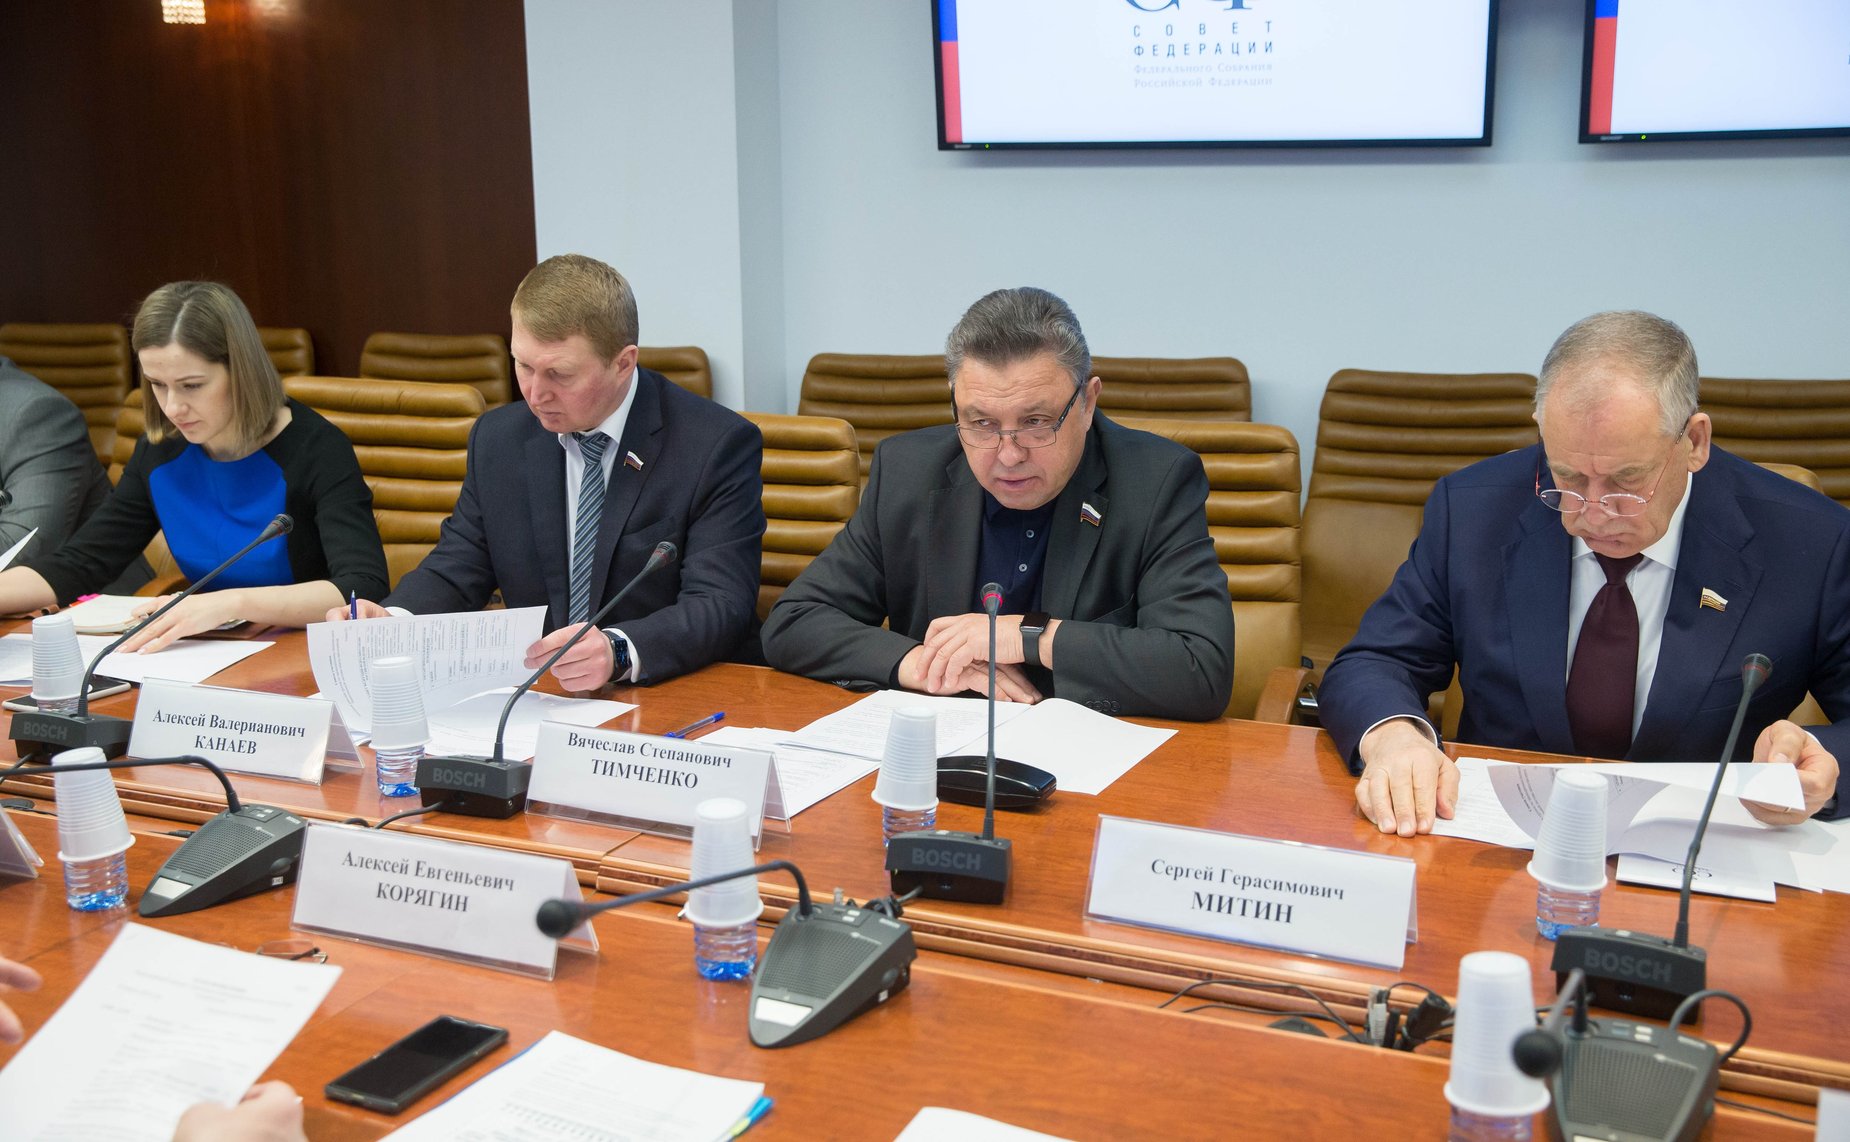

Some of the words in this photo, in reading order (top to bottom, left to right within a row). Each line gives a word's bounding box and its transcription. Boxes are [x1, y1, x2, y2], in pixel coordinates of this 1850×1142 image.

[1133, 20, 1272, 38] СОВЕТ
[1133, 41, 1273, 58] ФЕДЕРАЦИИ
[23, 721, 68, 740] BOSCH
[152, 709, 206, 727] Алексей
[209, 714, 306, 738] Валерианович
[194, 735, 257, 755] КАНАЕВ
[567, 731, 635, 755] Вячеслав
[640, 742, 732, 768] Степанович
[432, 767, 486, 788] BOSCH
[591, 758, 698, 789] ТИМЧЕНКО
[341, 851, 409, 875] Алексей
[414, 860, 516, 891] Евгеньевич
[911, 847, 981, 870] BOSCH
[1151, 858, 1213, 881] Сергей
[1220, 868, 1345, 900] Герасимович
[375, 881, 469, 912] КОРЯГИН
[1191, 891, 1294, 924] МИТИН
[1583, 947, 1673, 982] BOSCH
